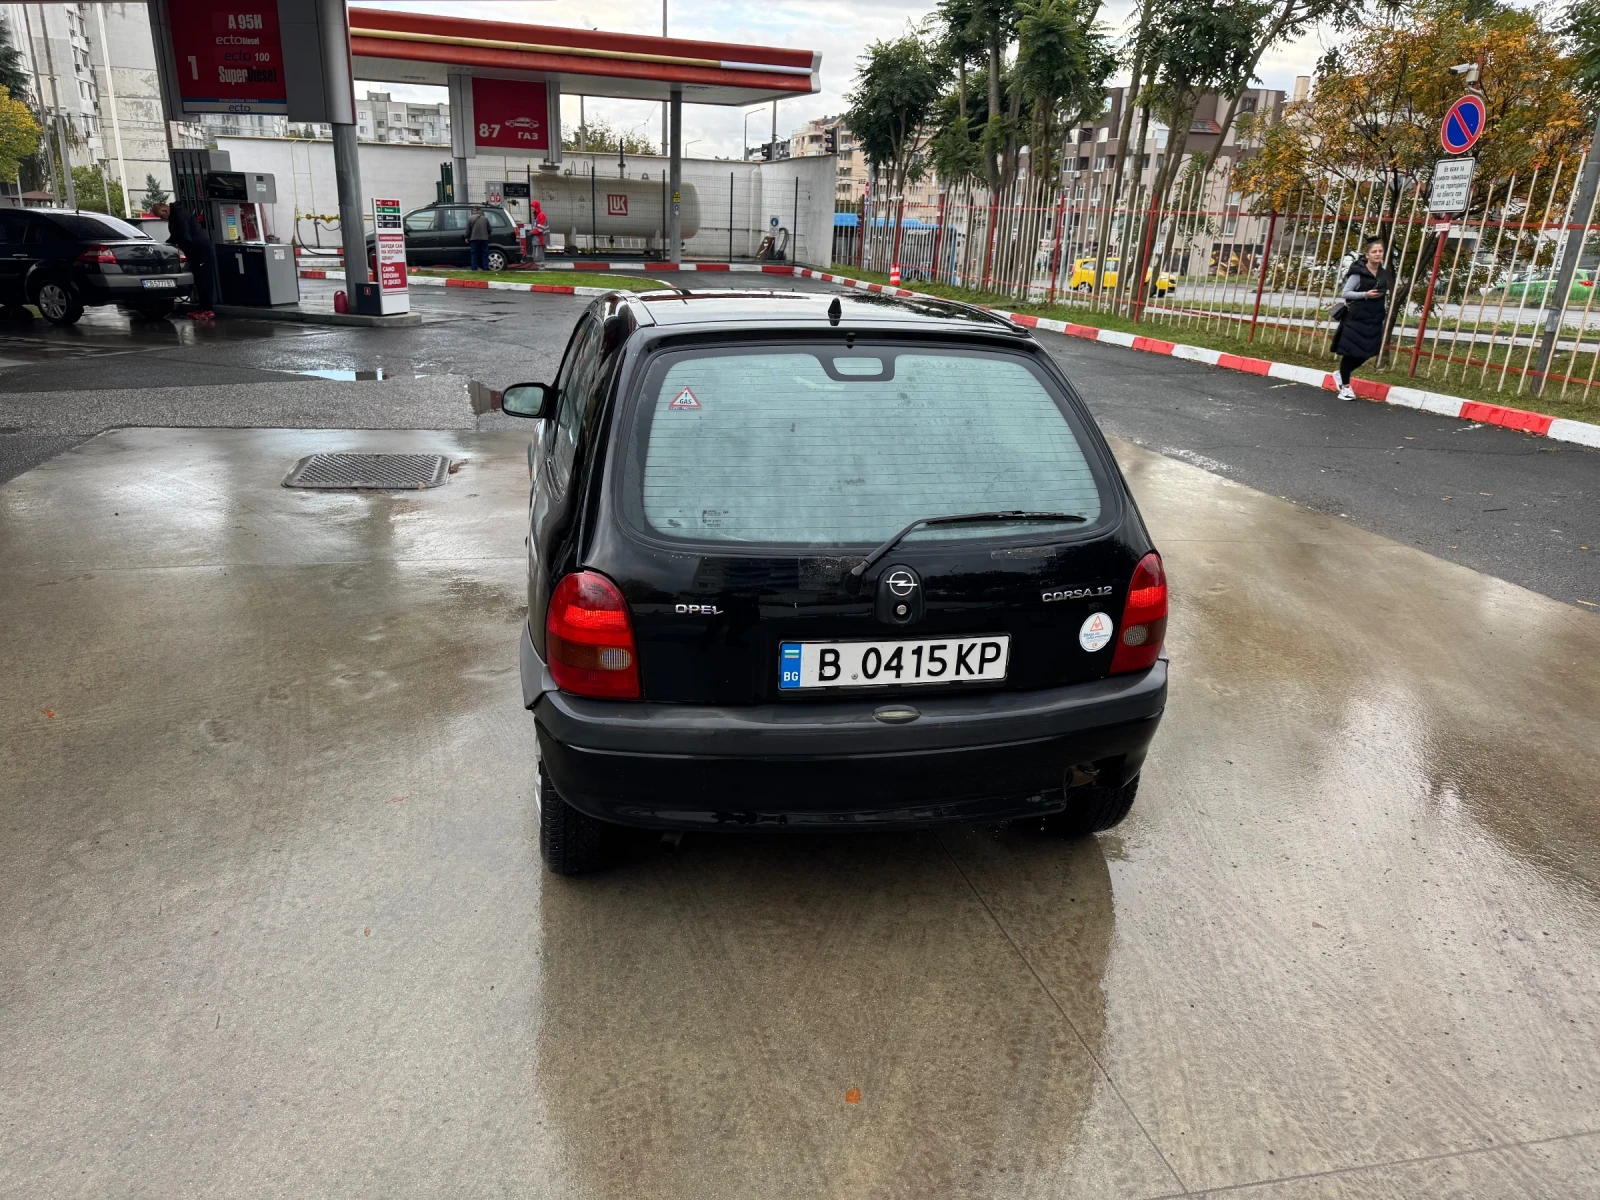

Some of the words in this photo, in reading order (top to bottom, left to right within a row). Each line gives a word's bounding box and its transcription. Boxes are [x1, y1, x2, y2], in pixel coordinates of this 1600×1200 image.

[254, 52, 270, 61] 100
[187, 55, 198, 80] 1
[228, 103, 251, 112] ecto
[479, 123, 501, 138] 8-7
[517, 131, 539, 140] ГАЗ
[235, 253, 244, 274] 1
[1042, 588, 1092, 602] CORSA
[675, 604, 724, 615] OPEL
[818, 648, 841, 681] B
[783, 672, 799, 682] BG
